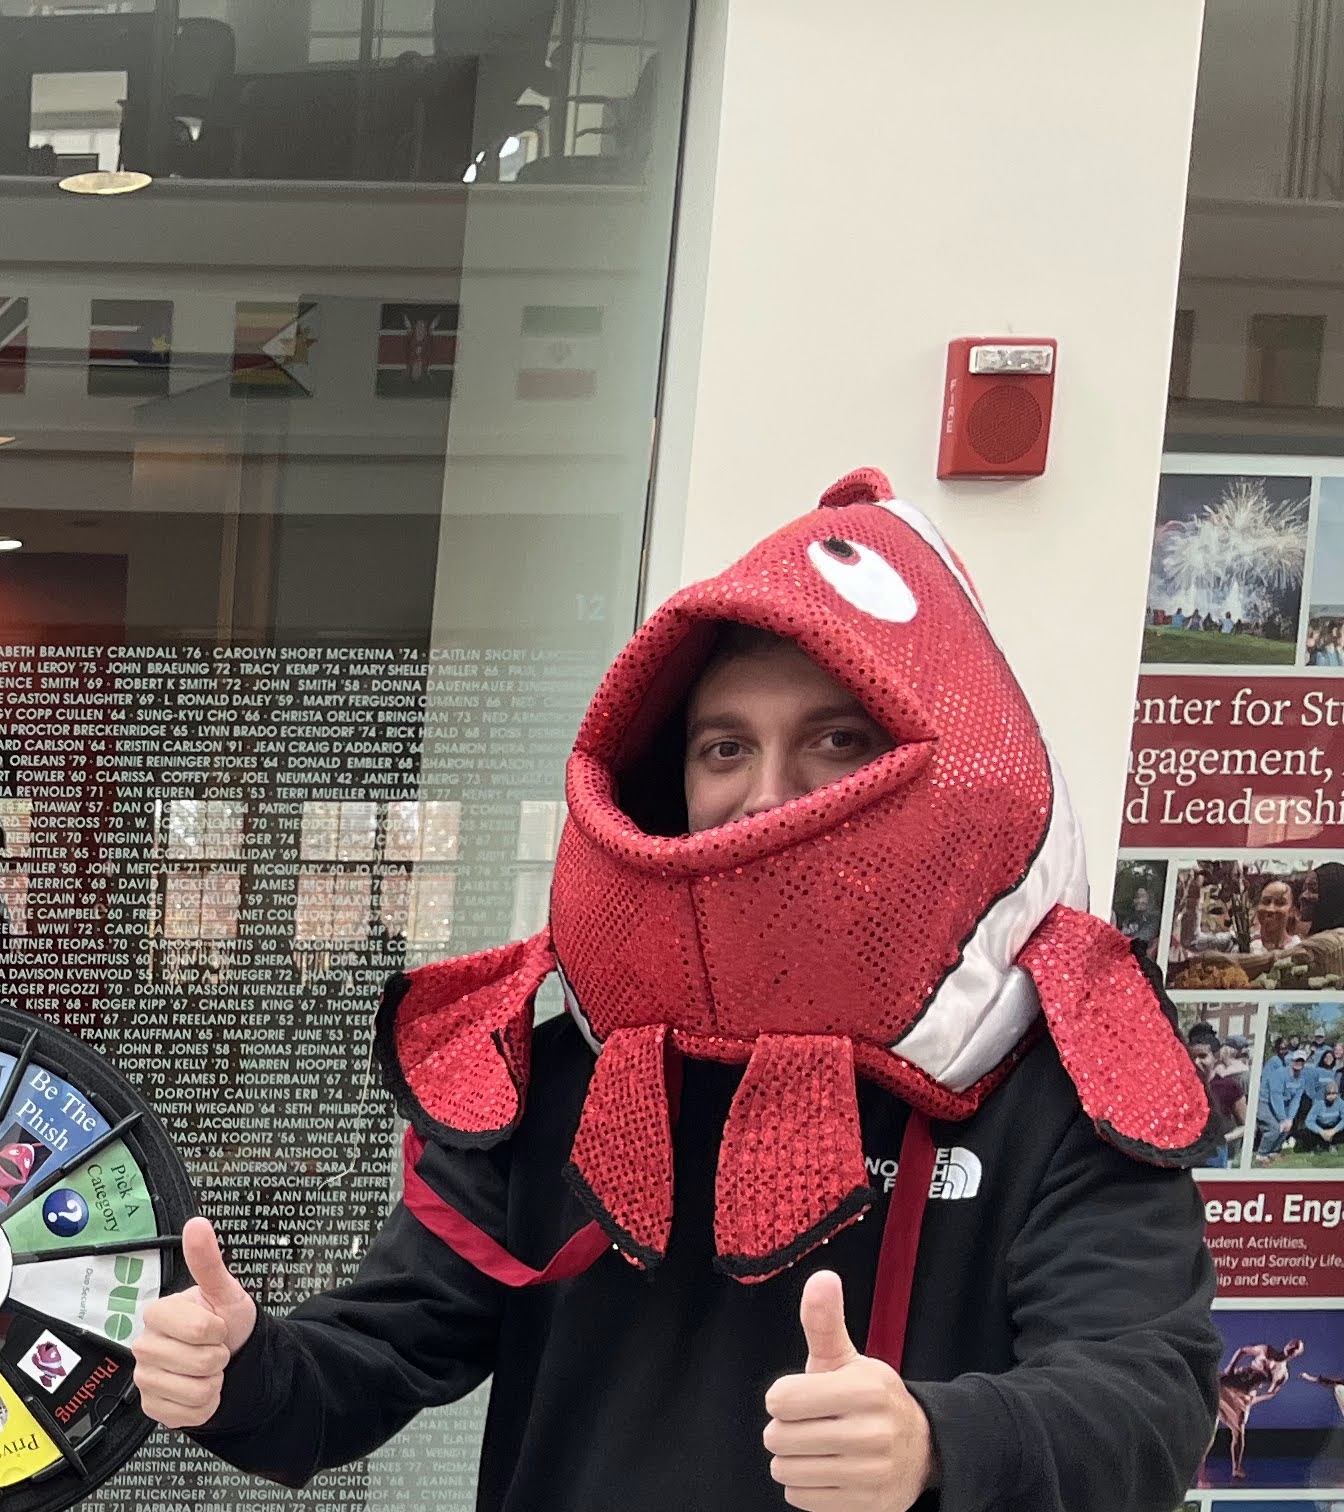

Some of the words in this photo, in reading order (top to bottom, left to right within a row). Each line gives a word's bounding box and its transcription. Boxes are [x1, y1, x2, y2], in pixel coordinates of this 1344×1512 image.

[38, 645, 104, 658] BRANTLEY
[106, 646, 178, 658] CRANDALL
[181, 646, 201, 658] '76
[212, 647, 276, 659] CAROLYN
[279, 647, 323, 659] SHORT
[325, 648, 394, 660] MCKENNA
[398, 648, 418, 660] '74
[1230, 688, 1291, 726] for
[1160, 788, 1344, 825] Leadershi
[174, 1073, 215, 1085] JAMES
[218, 1073, 232, 1085] D.
[234, 1073, 320, 1085] HOLDERBAUM
[322, 1073, 342, 1085] '67
[28, 1068, 58, 1098] Be
[63, 1092, 97, 1132] The
[14, 1098, 70, 1152] Phish
[87, 1164, 120, 1233] Category
[110, 1164, 134, 1199] Pick
[125, 1204, 140, 1218] A
[1204, 1193, 1273, 1223] ead.
[1283, 1194, 1344, 1228] Eng
[1247, 1236, 1308, 1250] Activities,
[1234, 1272, 1258, 1286] and
[1261, 1272, 1309, 1286] Service.
[1242, 1254, 1266, 1268] and
[1268, 1255, 1317, 1270] Sorority
[77, 1286, 90, 1320] Security
[54, 1356, 120, 1424] Phishing
